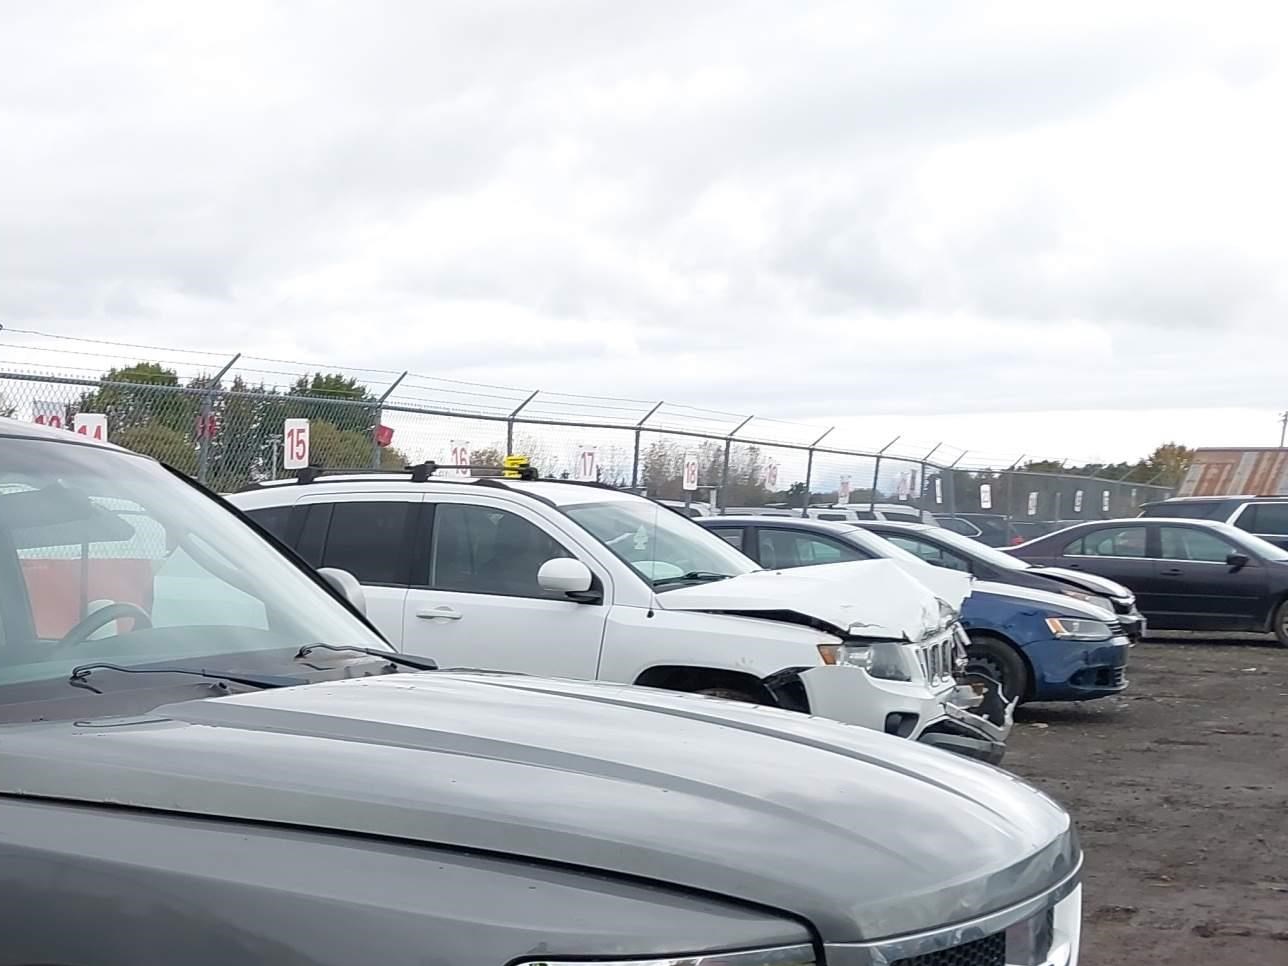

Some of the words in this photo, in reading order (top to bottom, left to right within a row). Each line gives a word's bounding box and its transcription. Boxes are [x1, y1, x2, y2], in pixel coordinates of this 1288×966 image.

[287, 428, 306, 460] 15
[451, 447, 468, 475] 16
[581, 451, 595, 477] 17
